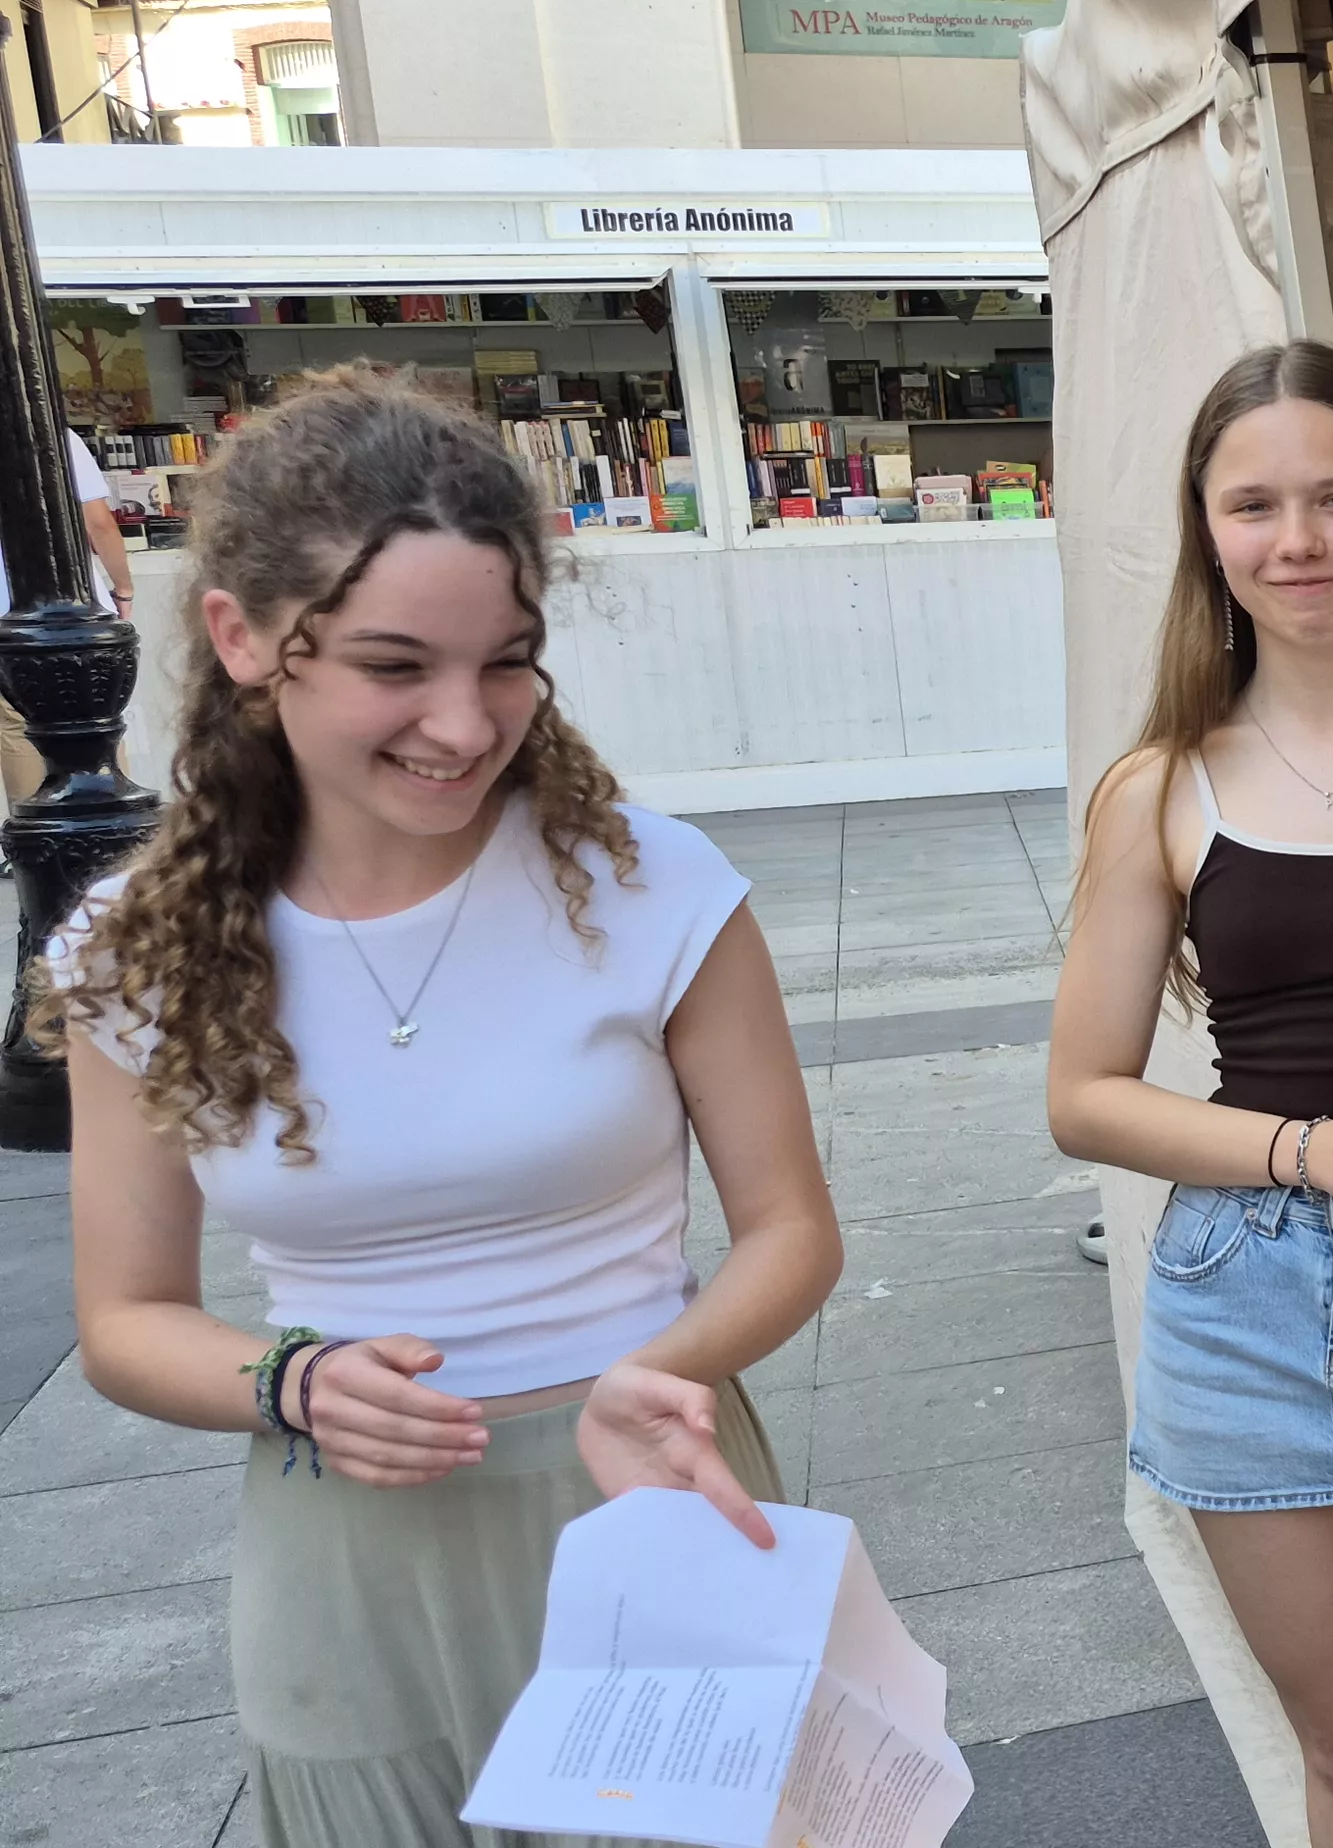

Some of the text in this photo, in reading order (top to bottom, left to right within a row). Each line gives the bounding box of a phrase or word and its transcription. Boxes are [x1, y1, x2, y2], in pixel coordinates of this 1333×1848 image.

[789, 9, 862, 35] MPA
[866, 11, 1033, 28] Museo Pedagógico de Aragón
[581, 207, 794, 232] Librería Anónima
